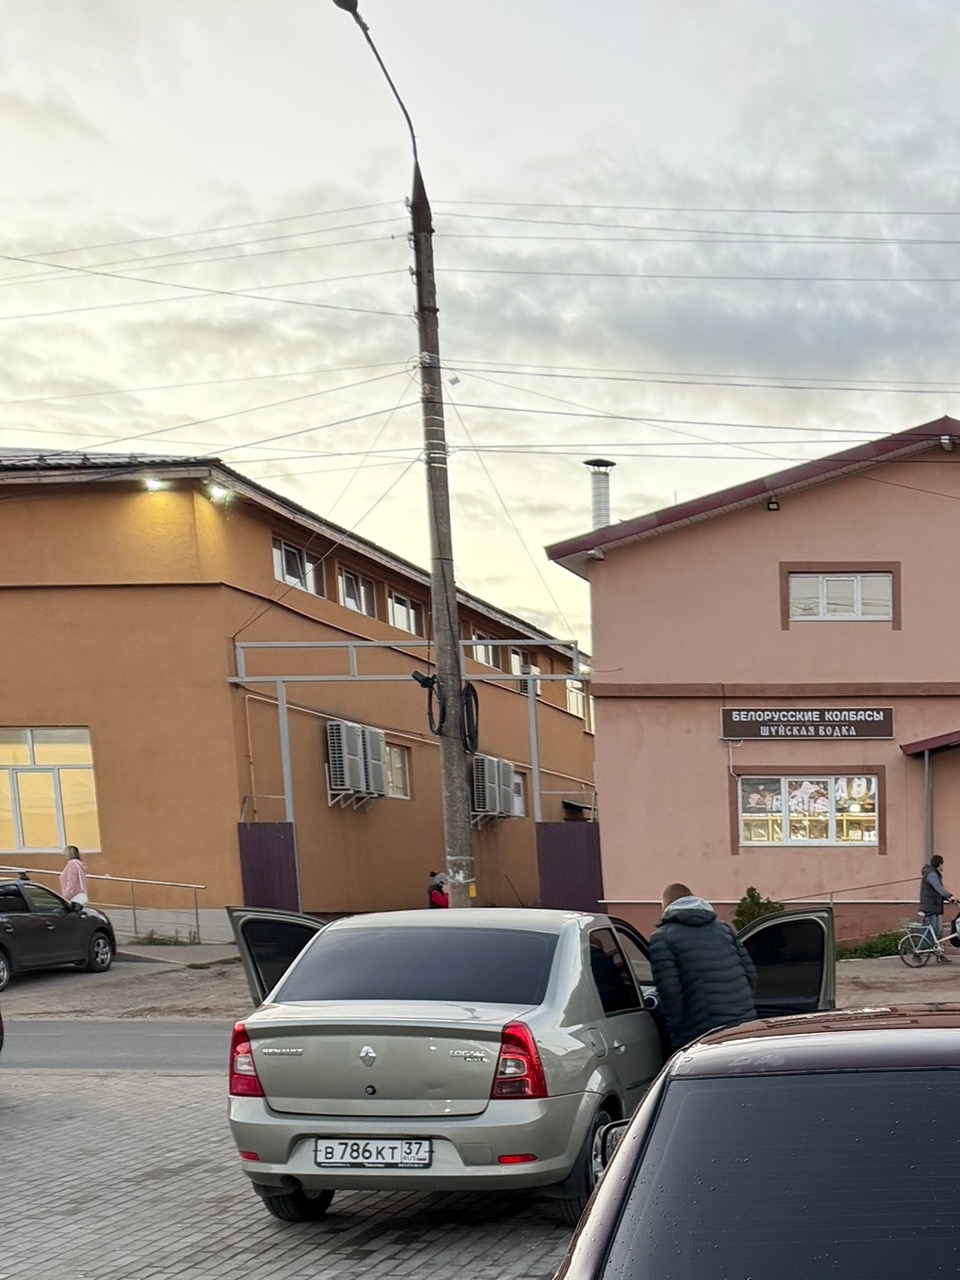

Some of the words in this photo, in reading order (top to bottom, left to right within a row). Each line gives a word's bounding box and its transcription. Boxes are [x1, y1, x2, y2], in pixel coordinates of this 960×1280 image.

[732, 711, 820, 721] БЕЛОРУССКИЕ
[825, 711, 884, 721] КОЛБАСЫ
[760, 725, 815, 736] ШУЙСКАЯ
[819, 726, 857, 736] ВОДКА
[404, 1142, 423, 1155] 37
